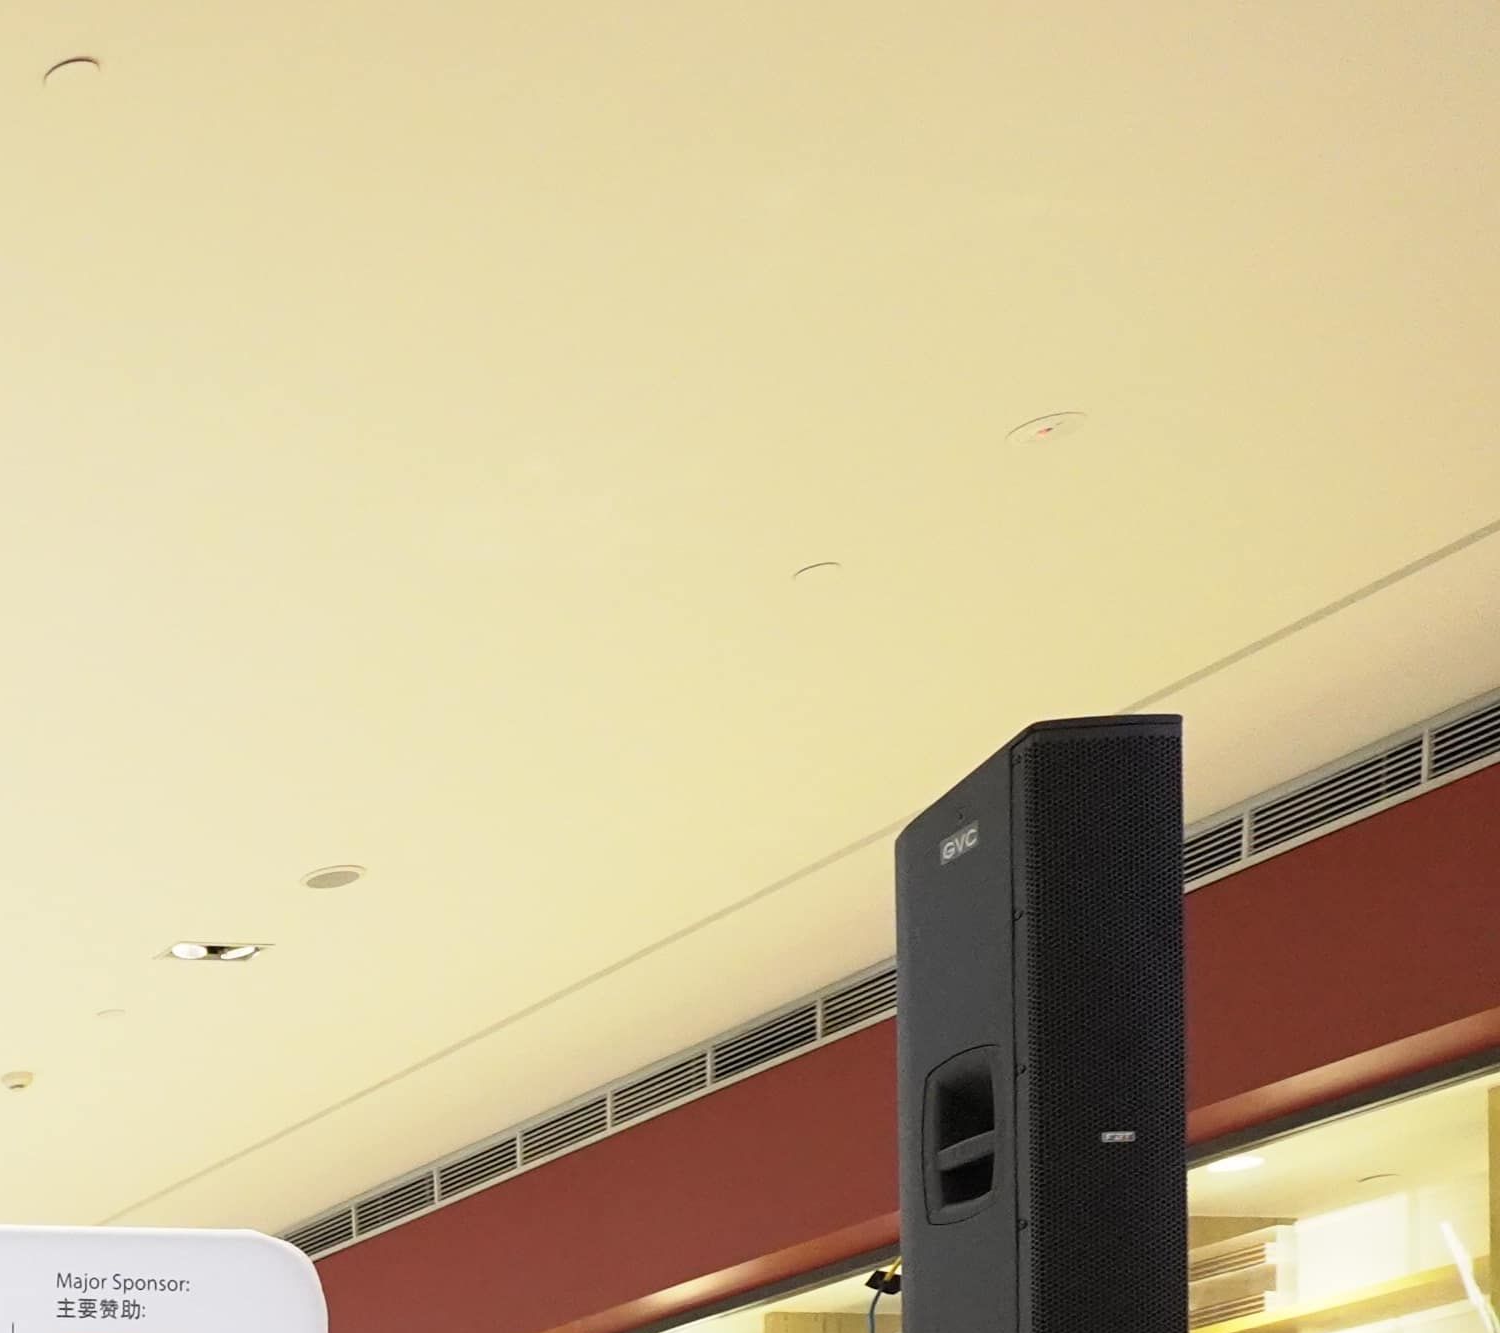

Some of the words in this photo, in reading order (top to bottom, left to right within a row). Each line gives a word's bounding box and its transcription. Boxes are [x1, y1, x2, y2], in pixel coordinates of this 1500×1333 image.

[57, 1273, 107, 1293] Major
[113, 1274, 189, 1294] Sponsor:
[56, 1298, 145, 1320] 主要赞助:
